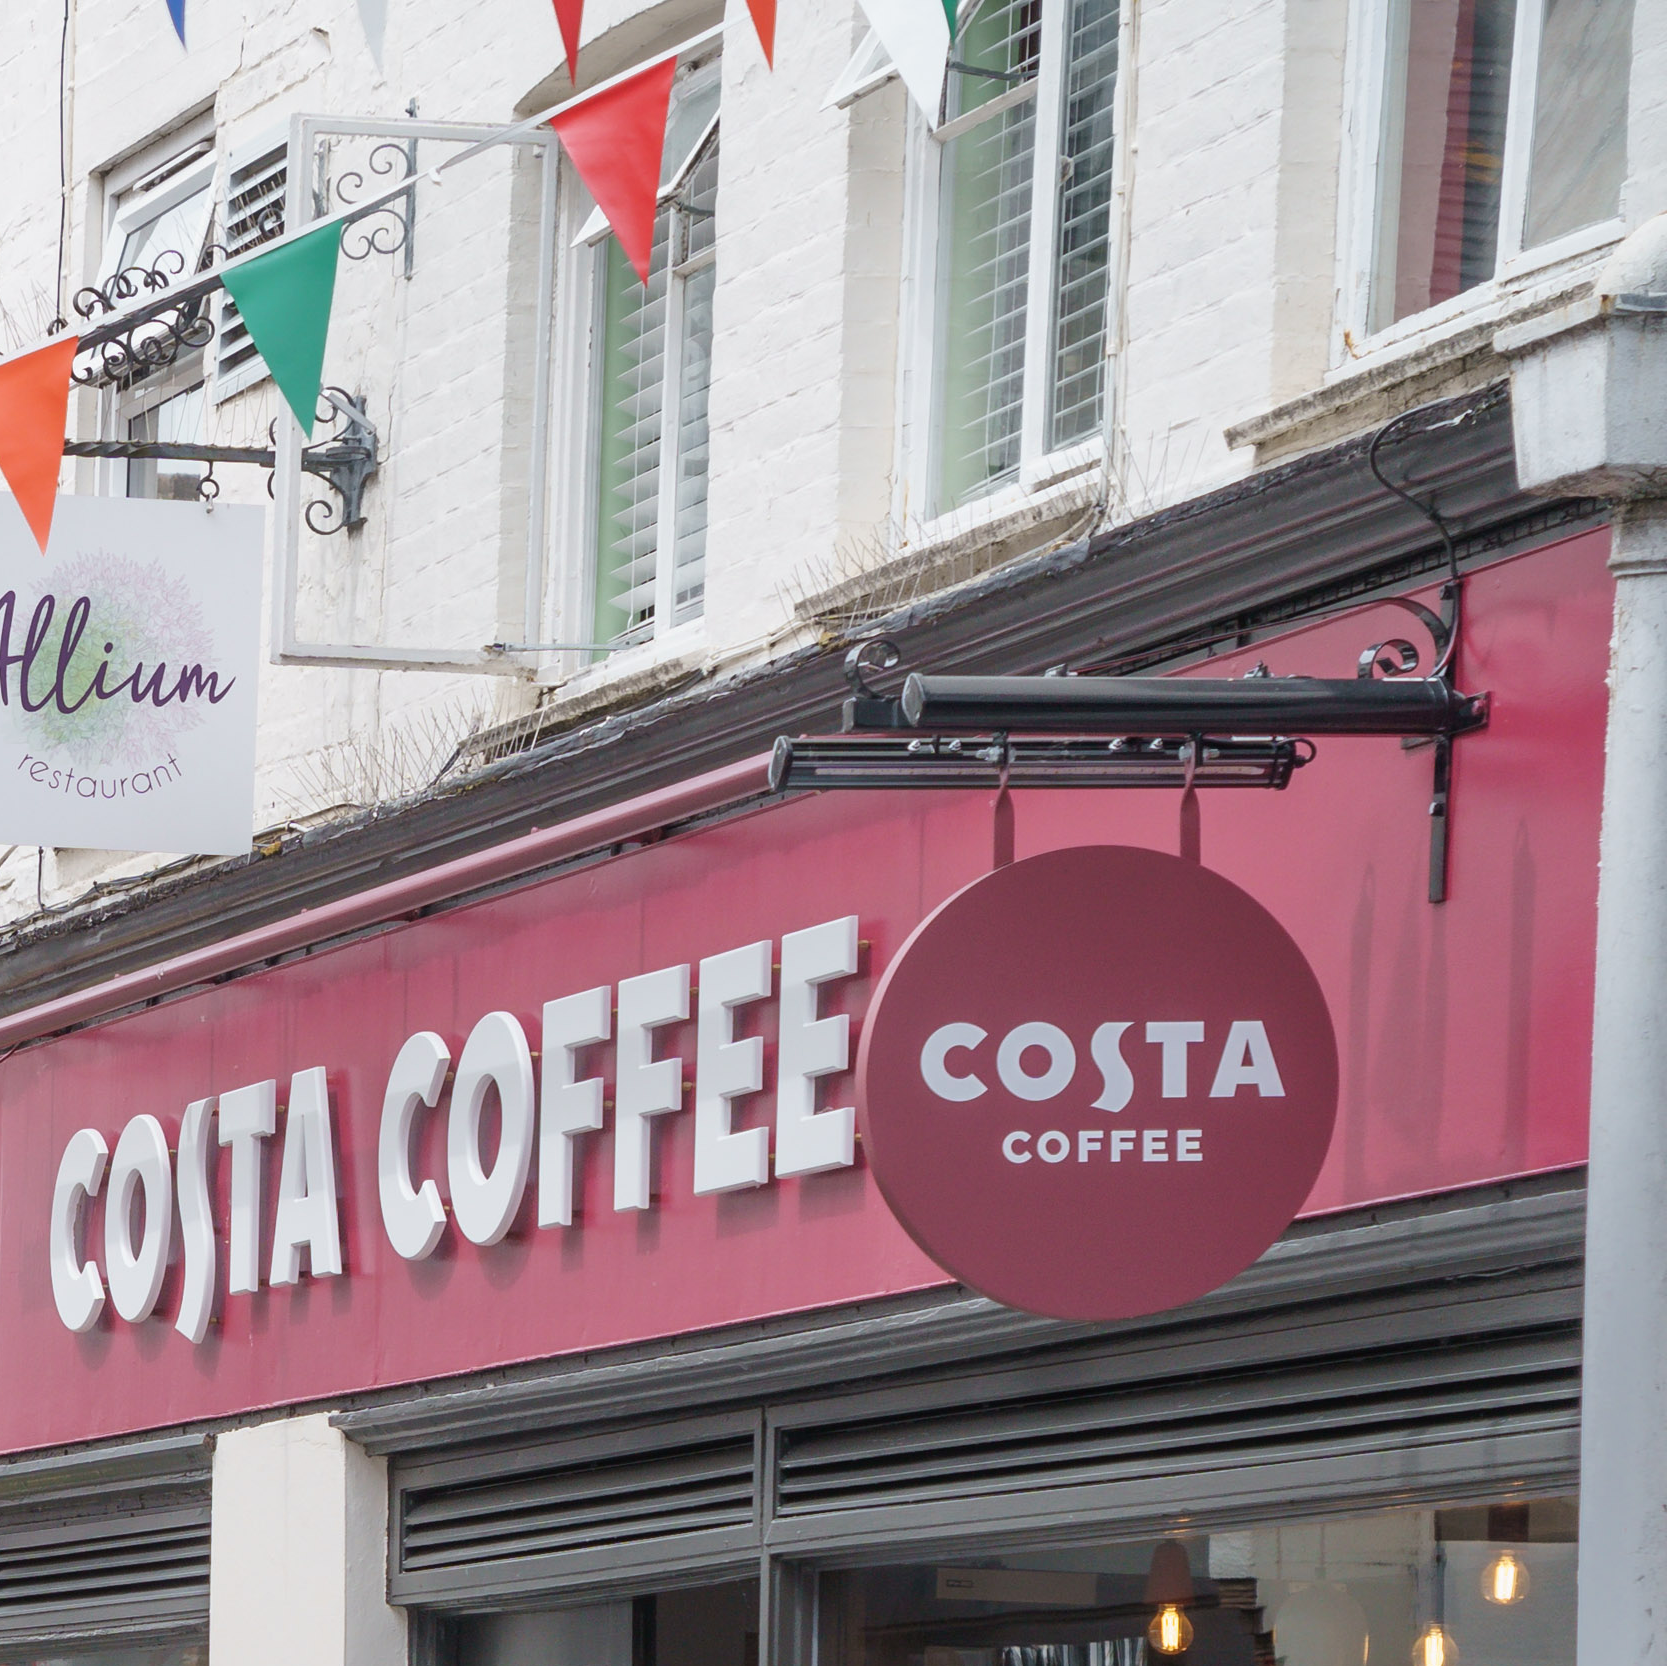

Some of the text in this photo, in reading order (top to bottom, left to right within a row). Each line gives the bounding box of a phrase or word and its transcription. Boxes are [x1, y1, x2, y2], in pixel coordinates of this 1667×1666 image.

[17, 752, 183, 800] restaurant
[919, 1020, 1286, 1113] COSTA
[49, 914, 859, 1346] COSTA COFFEE
[1001, 1128, 1204, 1164] COFFEE
